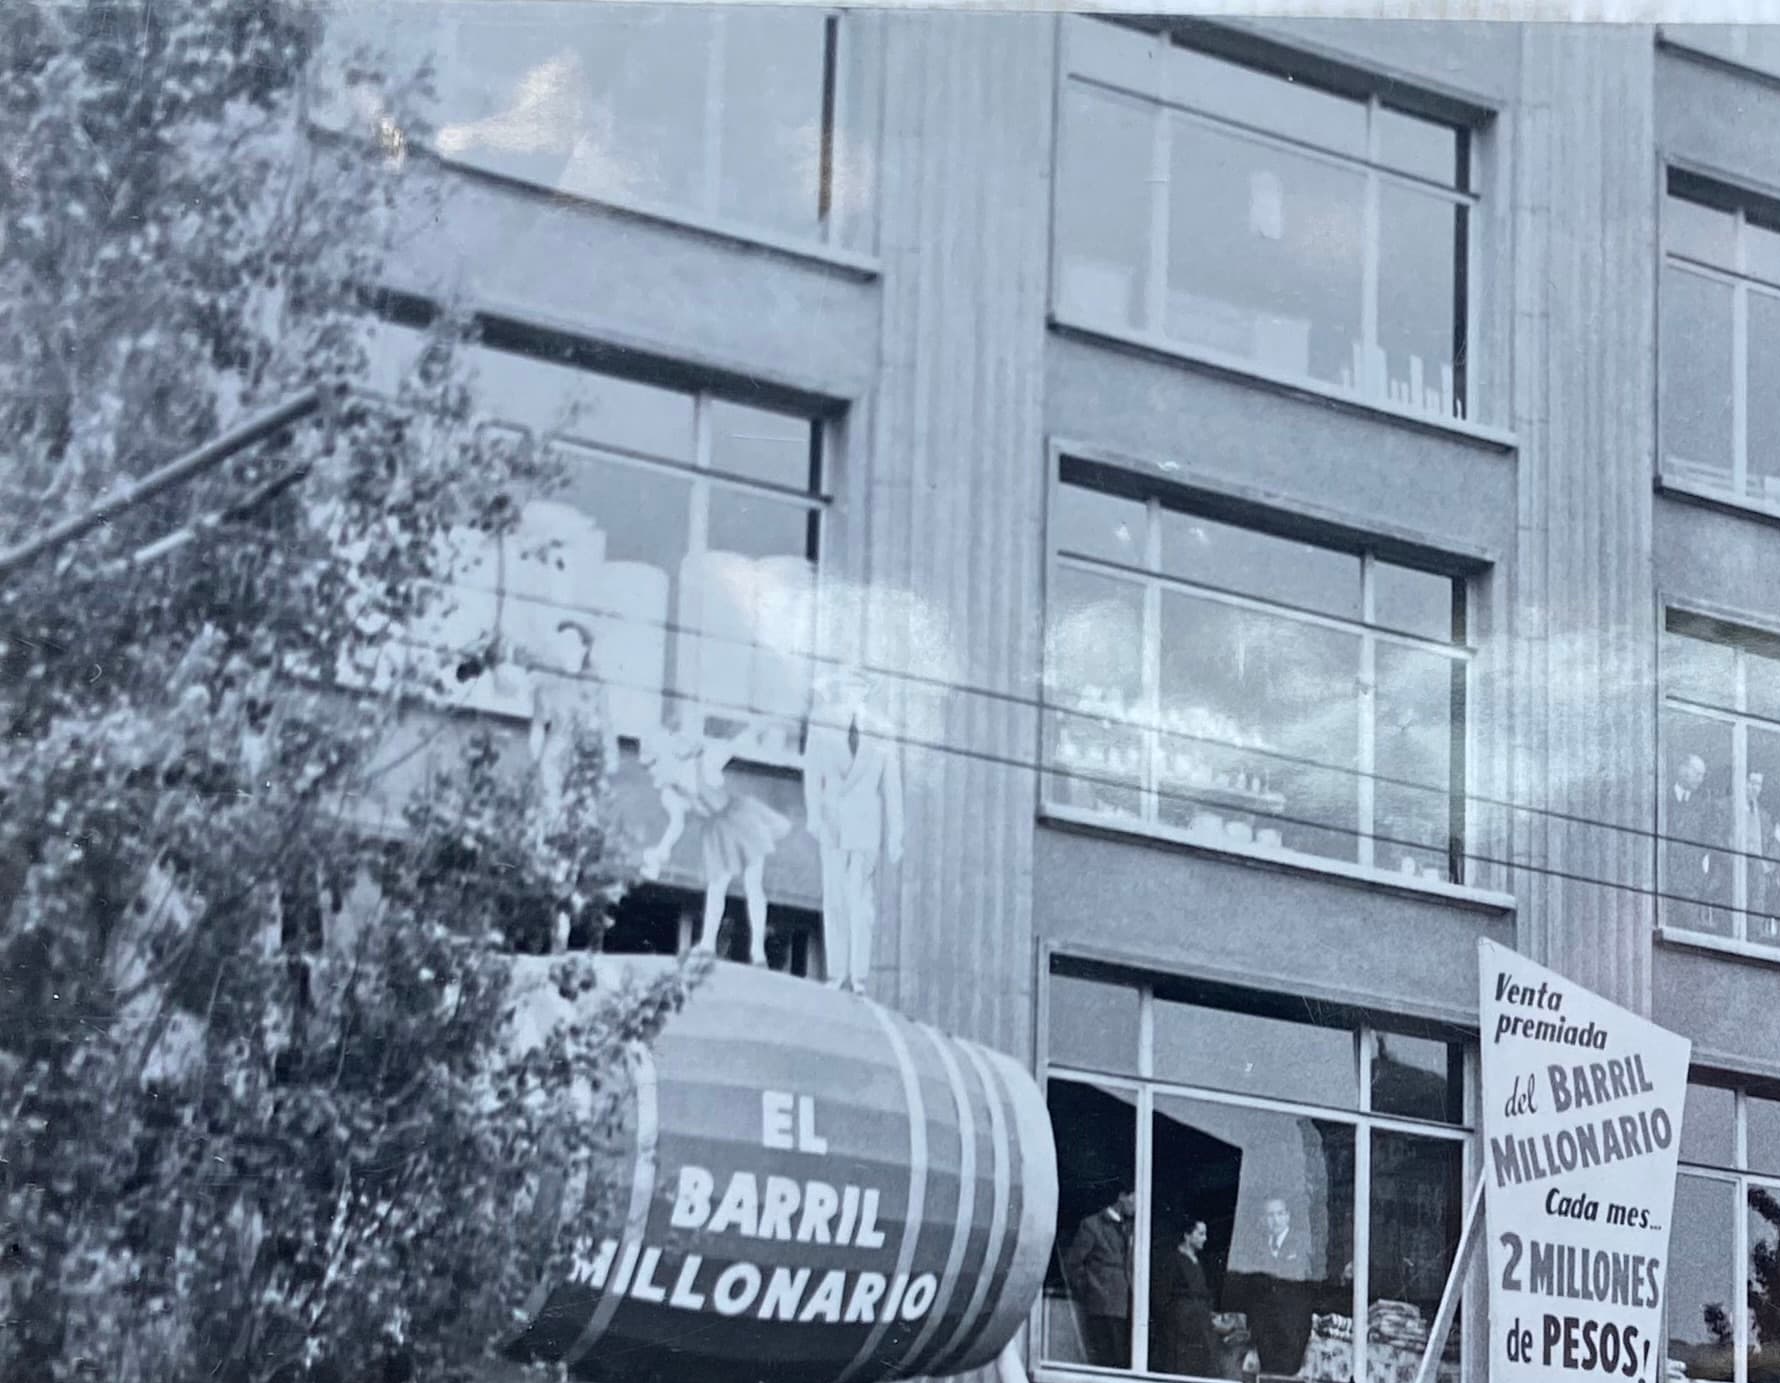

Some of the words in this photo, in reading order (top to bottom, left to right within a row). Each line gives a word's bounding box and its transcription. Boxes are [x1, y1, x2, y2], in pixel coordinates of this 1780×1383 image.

[1495, 972, 1563, 1012] Venta
[1494, 1013, 1608, 1051] premiada
[1504, 1074, 1538, 1117] del
[1547, 1053, 1653, 1113] BARRIL
[762, 1091, 827, 1155] EL
[1490, 1107, 1672, 1188] MILLONARIO
[670, 1166, 886, 1248] BARRIL
[1545, 1187, 1599, 1222] Cada
[567, 1238, 938, 1323] MILLONARIO
[1500, 1231, 1523, 1292] 2
[1530, 1241, 1659, 1309] MILLONES
[1506, 1316, 1533, 1364] de
